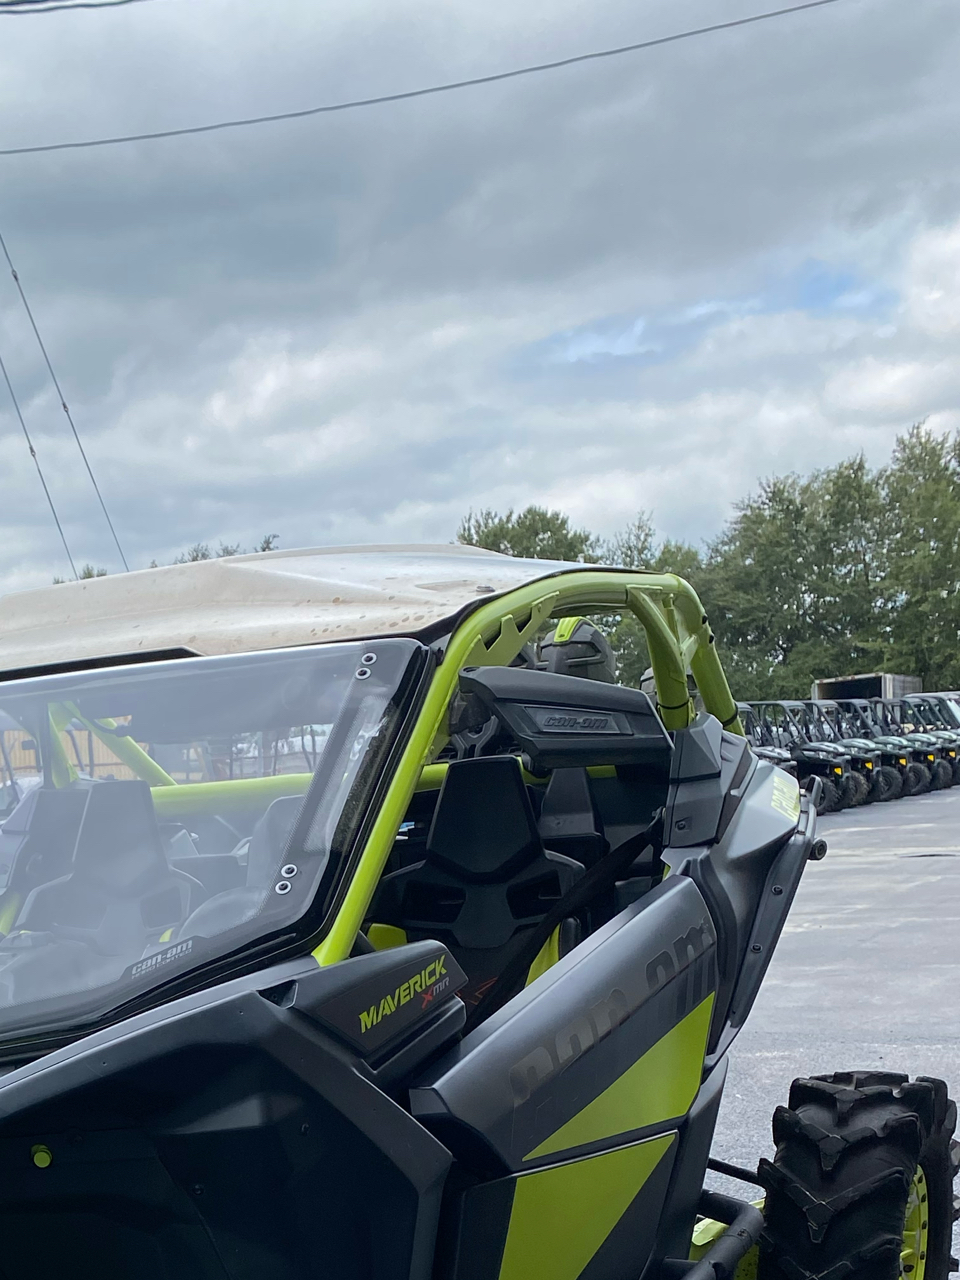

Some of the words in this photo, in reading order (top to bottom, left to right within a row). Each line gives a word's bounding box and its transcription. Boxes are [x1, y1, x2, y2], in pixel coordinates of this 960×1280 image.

[543, 715, 609, 729] can-am
[131, 940, 193, 975] can-am
[358, 954, 448, 1034] MAVERICK
